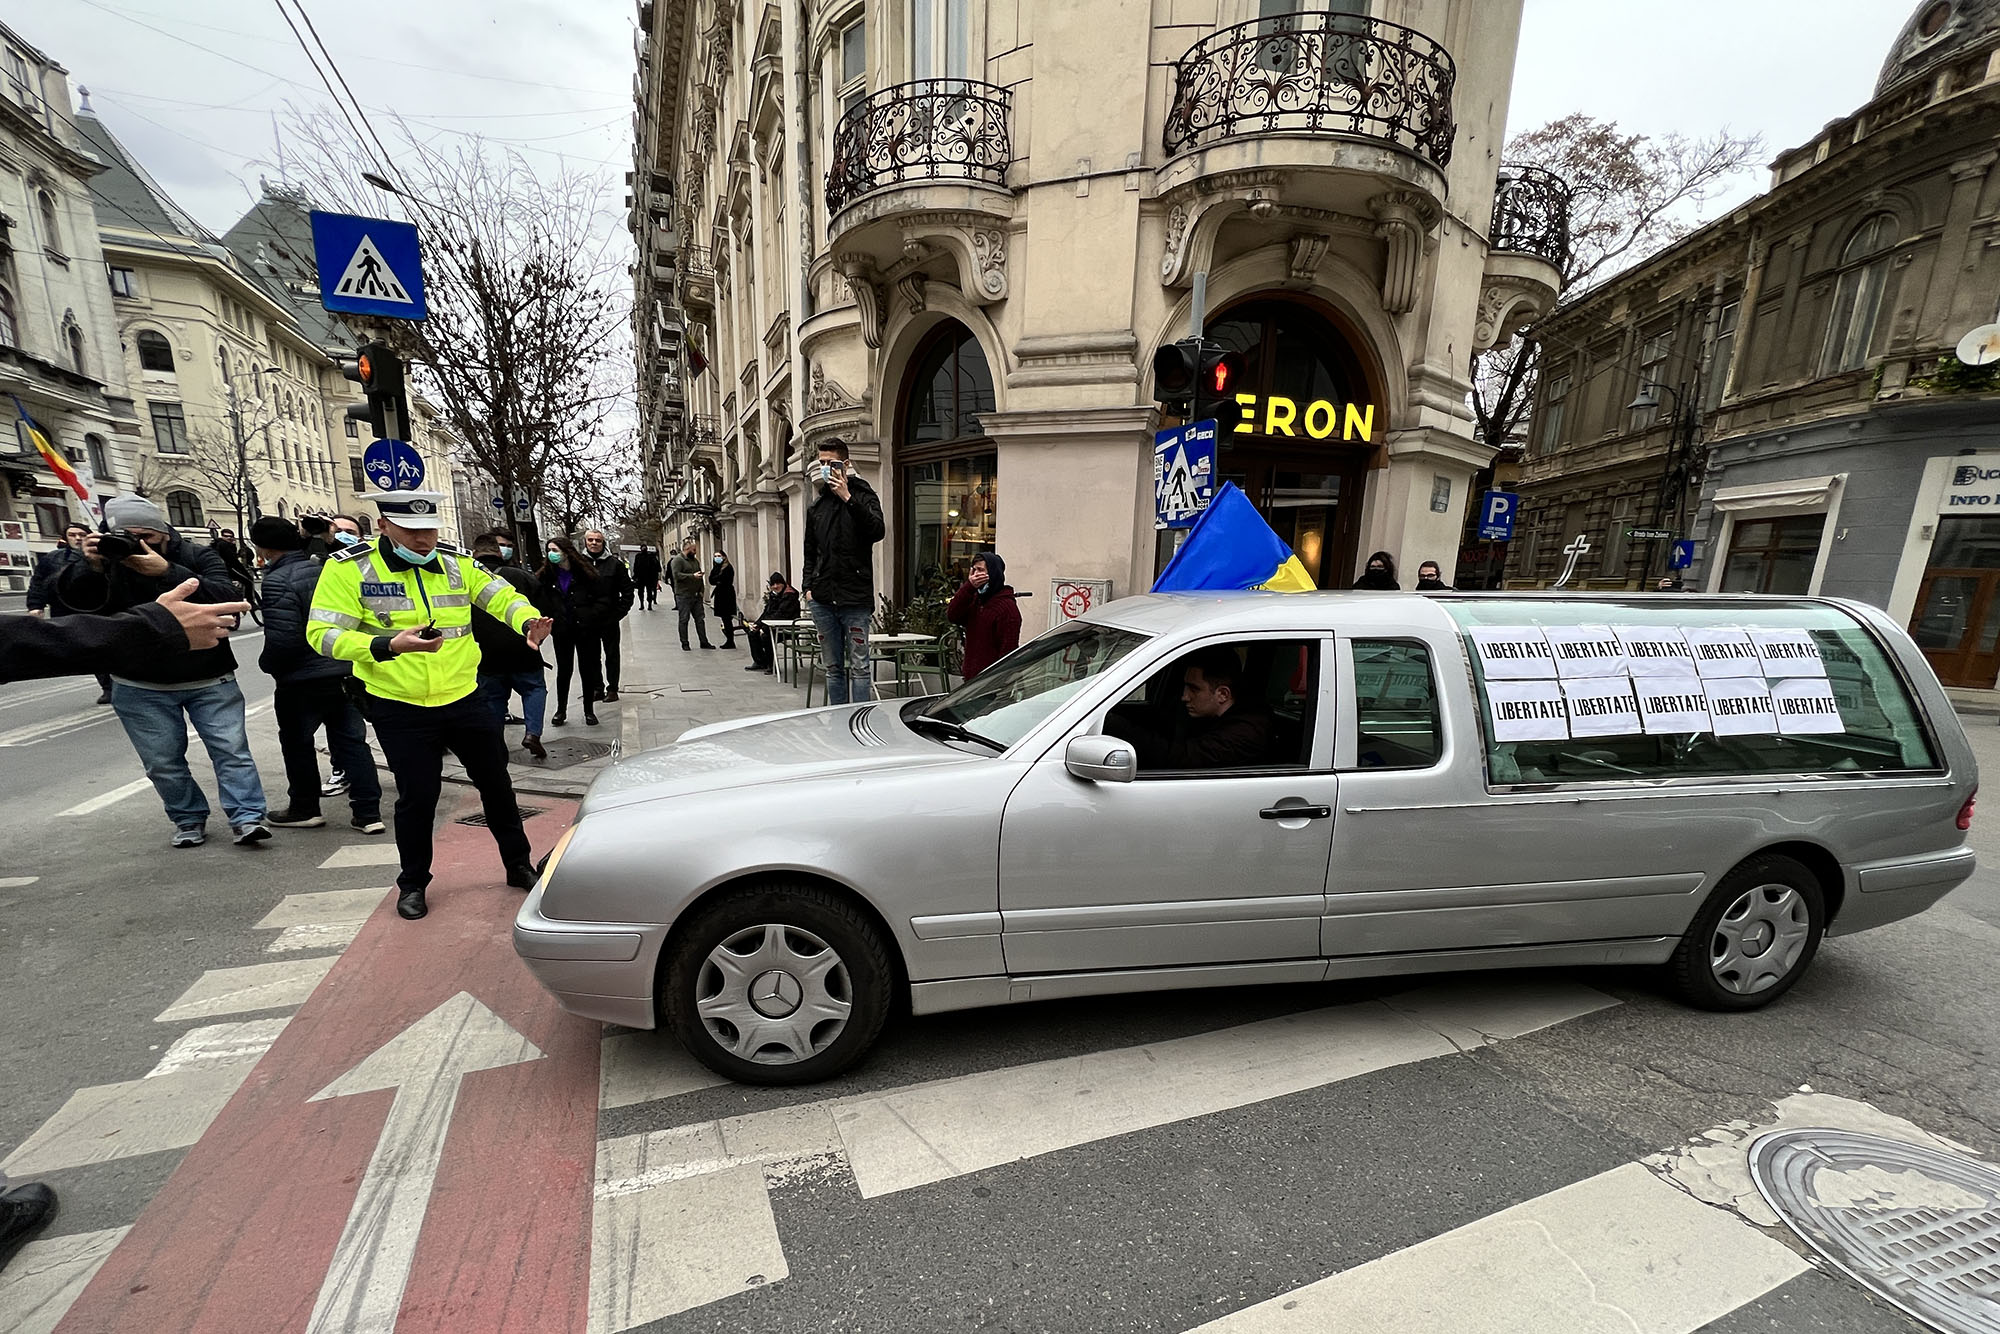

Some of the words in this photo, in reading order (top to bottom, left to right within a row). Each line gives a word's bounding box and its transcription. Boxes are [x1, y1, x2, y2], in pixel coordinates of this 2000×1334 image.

[1182, 393, 1375, 442] ERON
[1488, 497, 1509, 523] P
[1949, 495, 1991, 506] INFO
[1481, 641, 1551, 659] LIBERTATE
[1555, 640, 1623, 660] LIBERTATE
[1625, 641, 1691, 659] LIBERTATE
[1694, 642, 1757, 661] LIBERTATE
[1759, 642, 1821, 660] LIBERTATE
[1495, 700, 1565, 721] LIBERTATE
[1572, 695, 1637, 717] LIBERTATE
[1643, 694, 1707, 714] LIBERTATE
[1712, 696, 1773, 716] LIBERTATE
[1777, 697, 1837, 716] LIBERTATE
